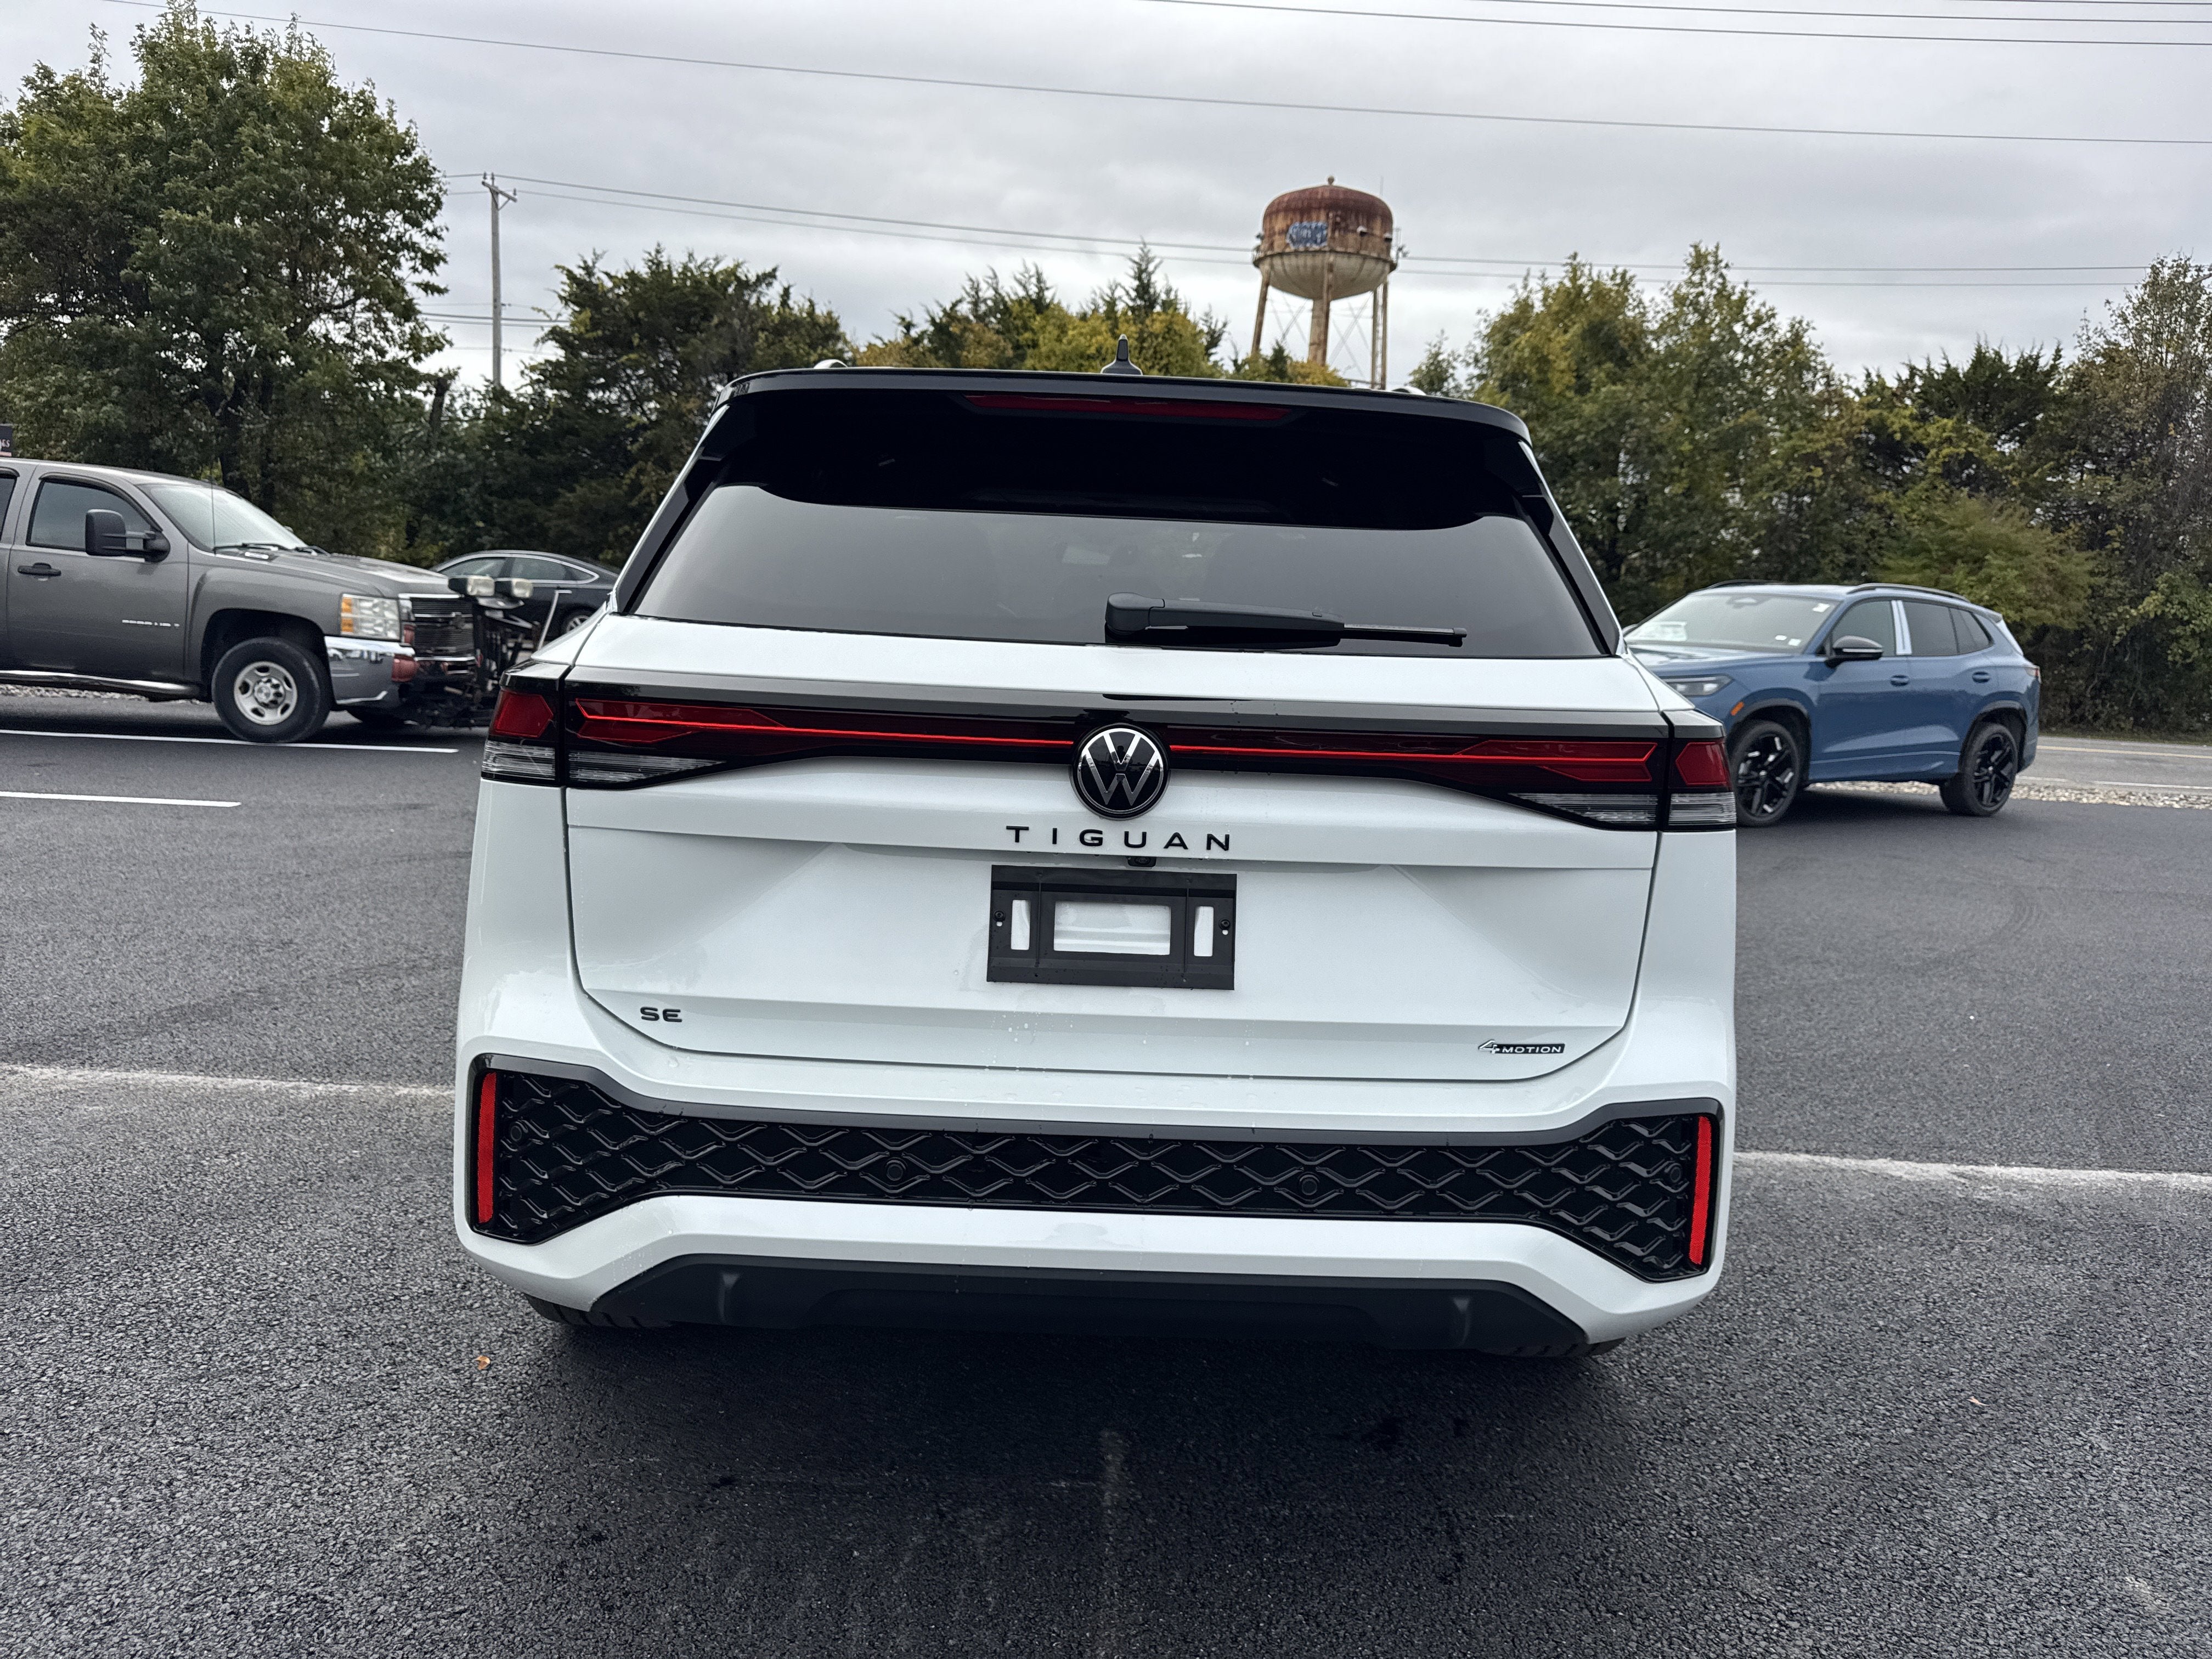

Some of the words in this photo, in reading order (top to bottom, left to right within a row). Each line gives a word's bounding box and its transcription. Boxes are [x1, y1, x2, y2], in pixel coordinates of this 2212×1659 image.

[1006, 825, 1230, 851] TIGUAN
[640, 1006, 682, 1023] SE
[1479, 1039, 1565, 1054] 4MOTION
